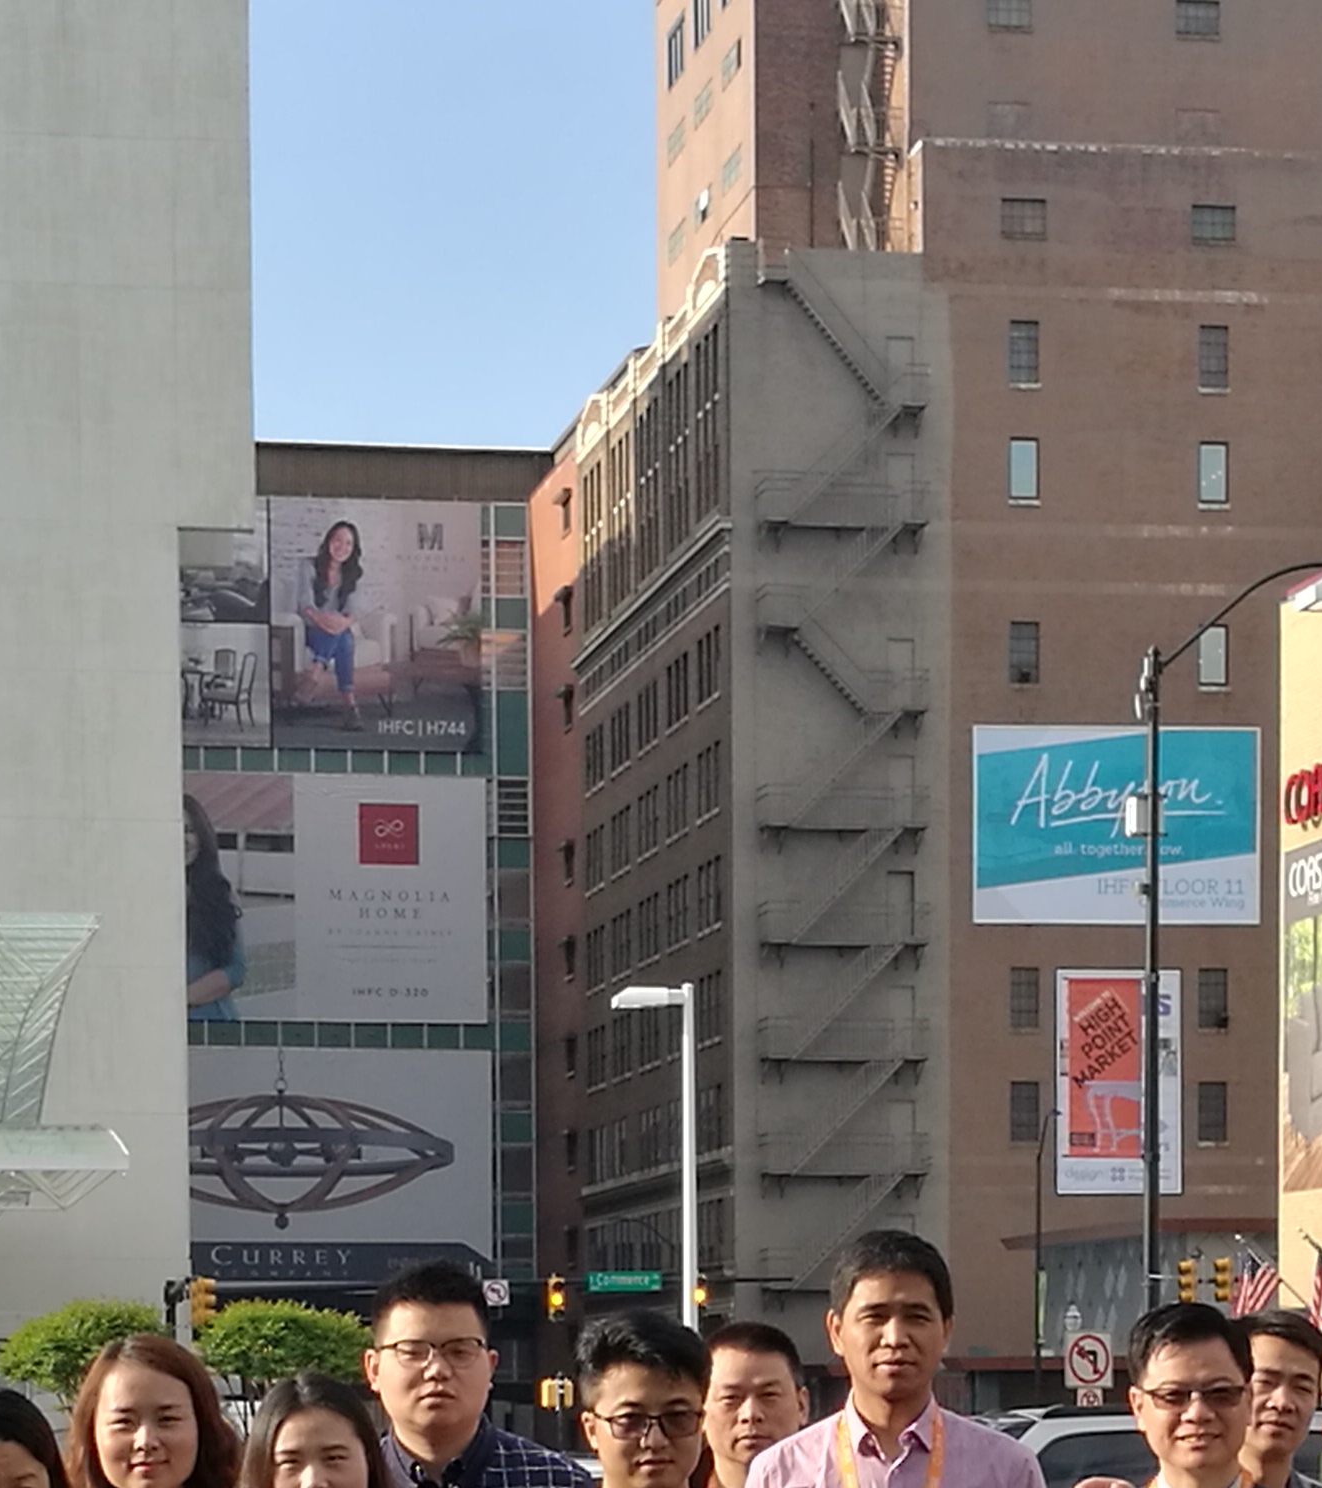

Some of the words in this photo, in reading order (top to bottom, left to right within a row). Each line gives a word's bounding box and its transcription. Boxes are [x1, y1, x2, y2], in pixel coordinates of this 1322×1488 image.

[426, 720, 466, 736] H744
[327, 889, 451, 903] MAGNOLIA
[1097, 879, 1137, 896] IHF
[1159, 879, 1218, 896] LOOR
[1225, 880, 1245, 895] 11
[358, 906, 422, 919] HOME
[1078, 997, 1123, 1037] HIGH
[1080, 1011, 1130, 1060] POINT
[1071, 1028, 1139, 1090] MARKET
